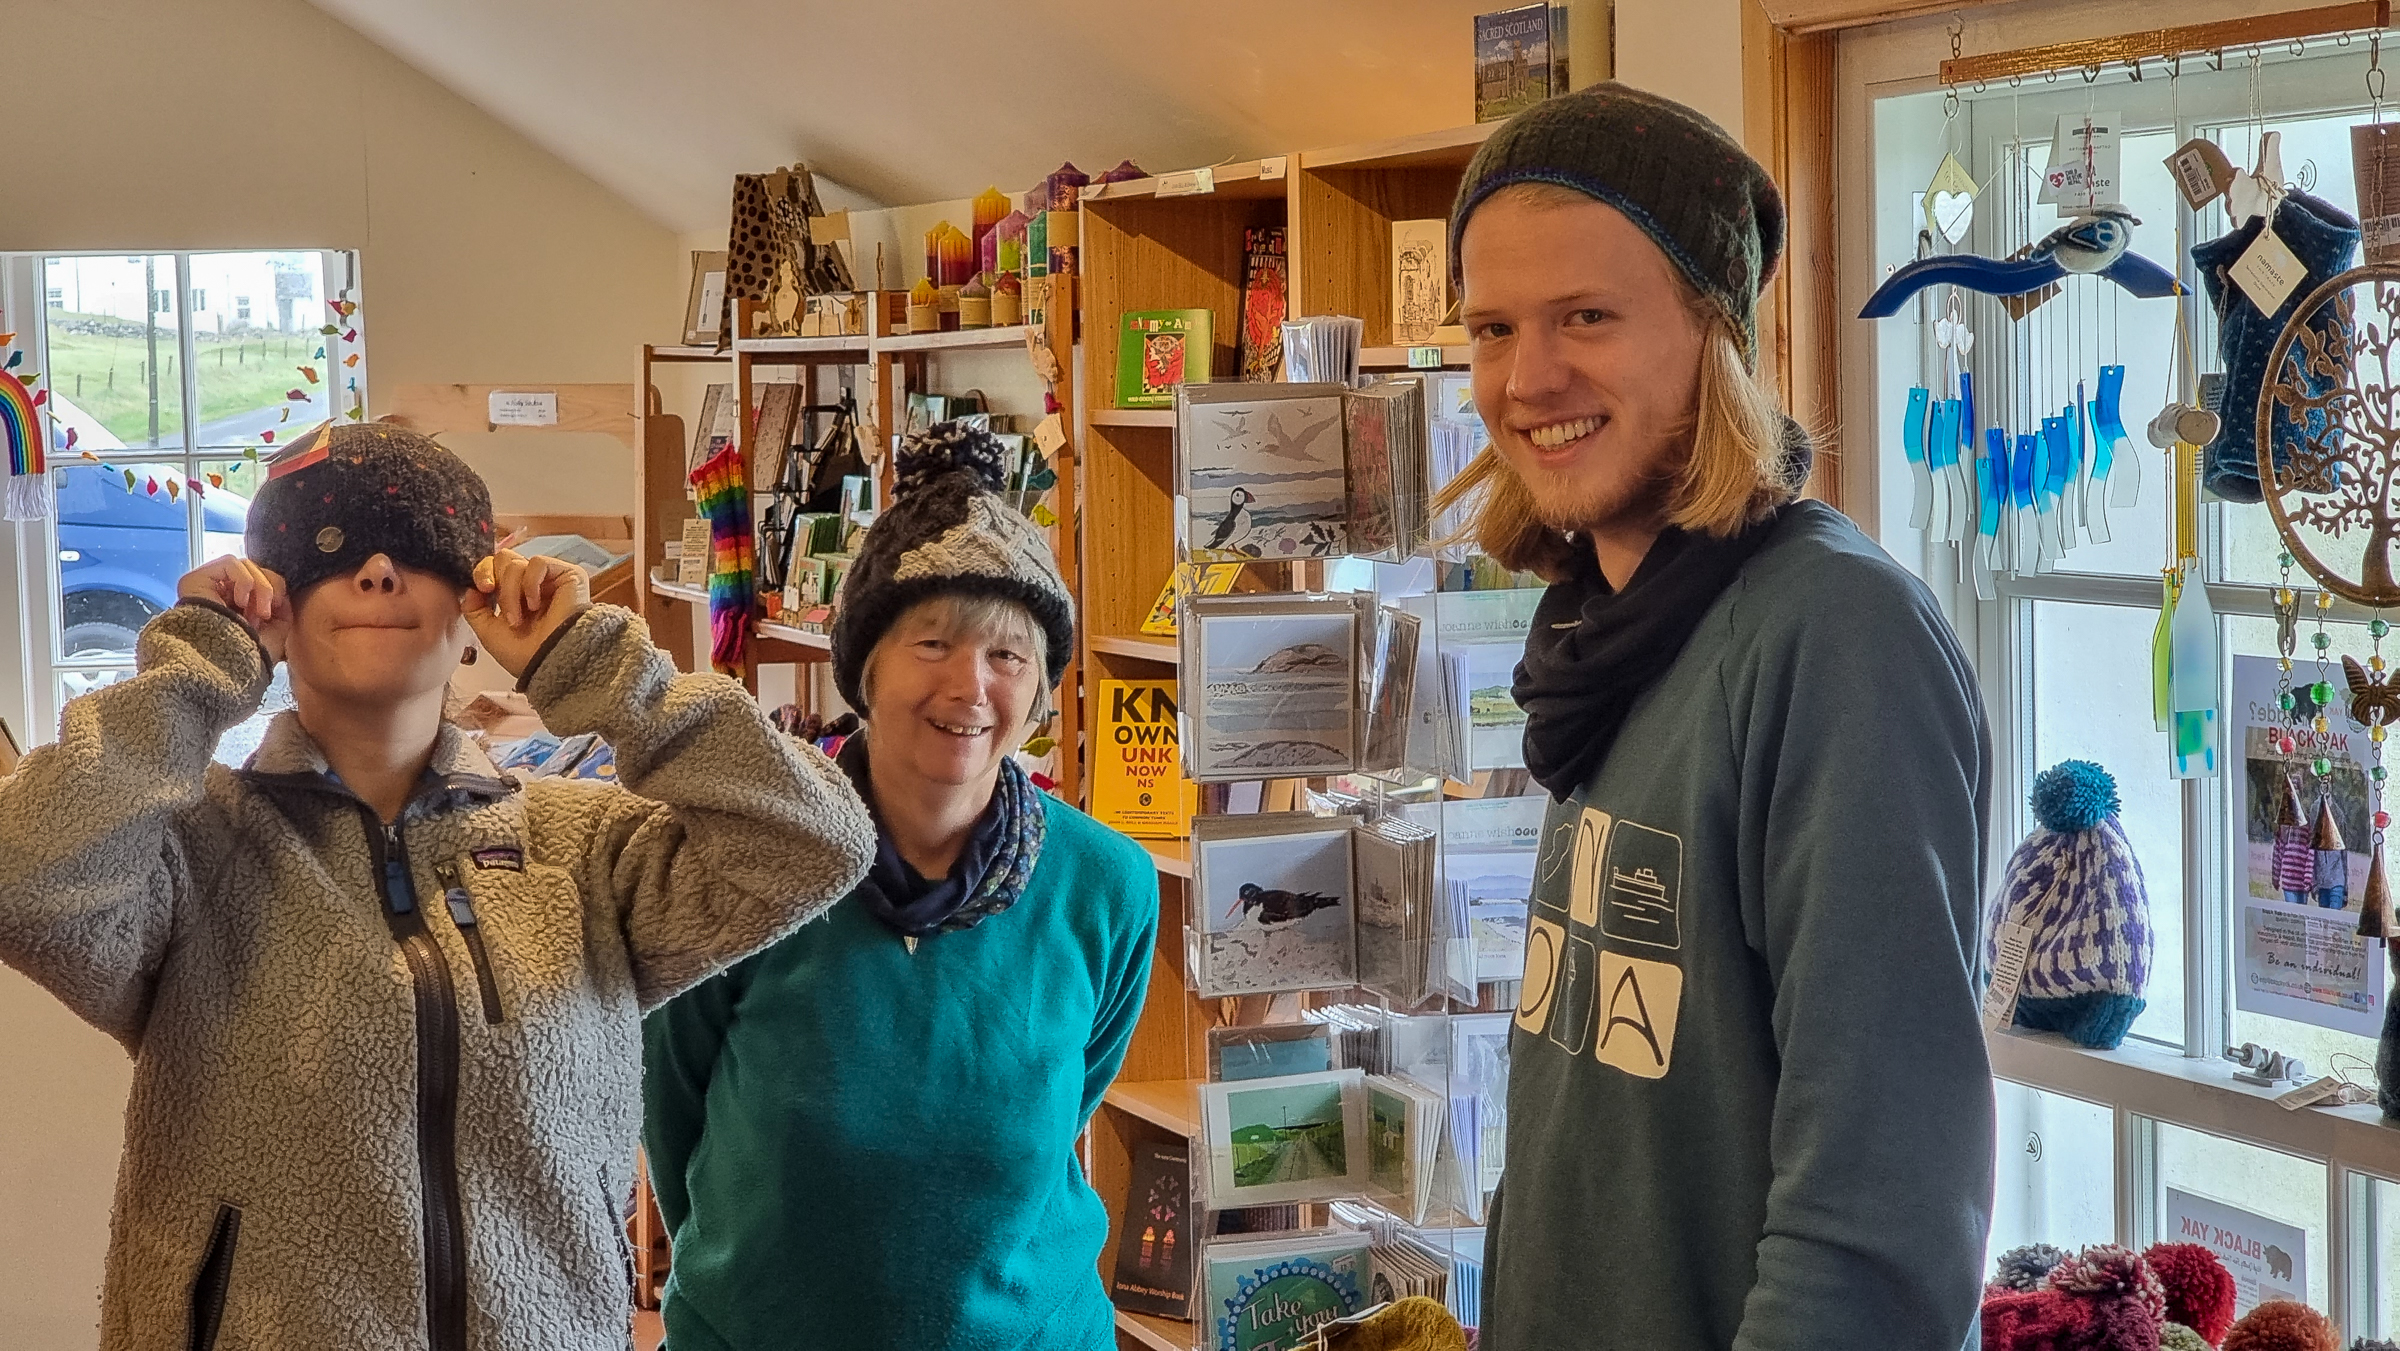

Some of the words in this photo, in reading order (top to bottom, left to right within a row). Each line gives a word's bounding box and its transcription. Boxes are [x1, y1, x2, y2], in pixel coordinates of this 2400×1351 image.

[1478, 26, 1504, 41] SACRED
[1504, 17, 1543, 37] SCOTLAND
[2257, 254, 2285, 286] namaste
[1112, 687, 1178, 723] KN
[1114, 725, 1179, 745] OWN
[1122, 747, 1173, 763] UNK
[1126, 765, 1167, 777] NOW
[1137, 778, 1154, 788] NS
[2266, 952, 2281, 966] Be
[2284, 960, 2297, 969] an
[2301, 960, 2362, 980] individual!
[1130, 1283, 1148, 1296] Abbey
[1149, 1287, 1171, 1299] Worship
[1240, 1292, 1302, 1331] Take
